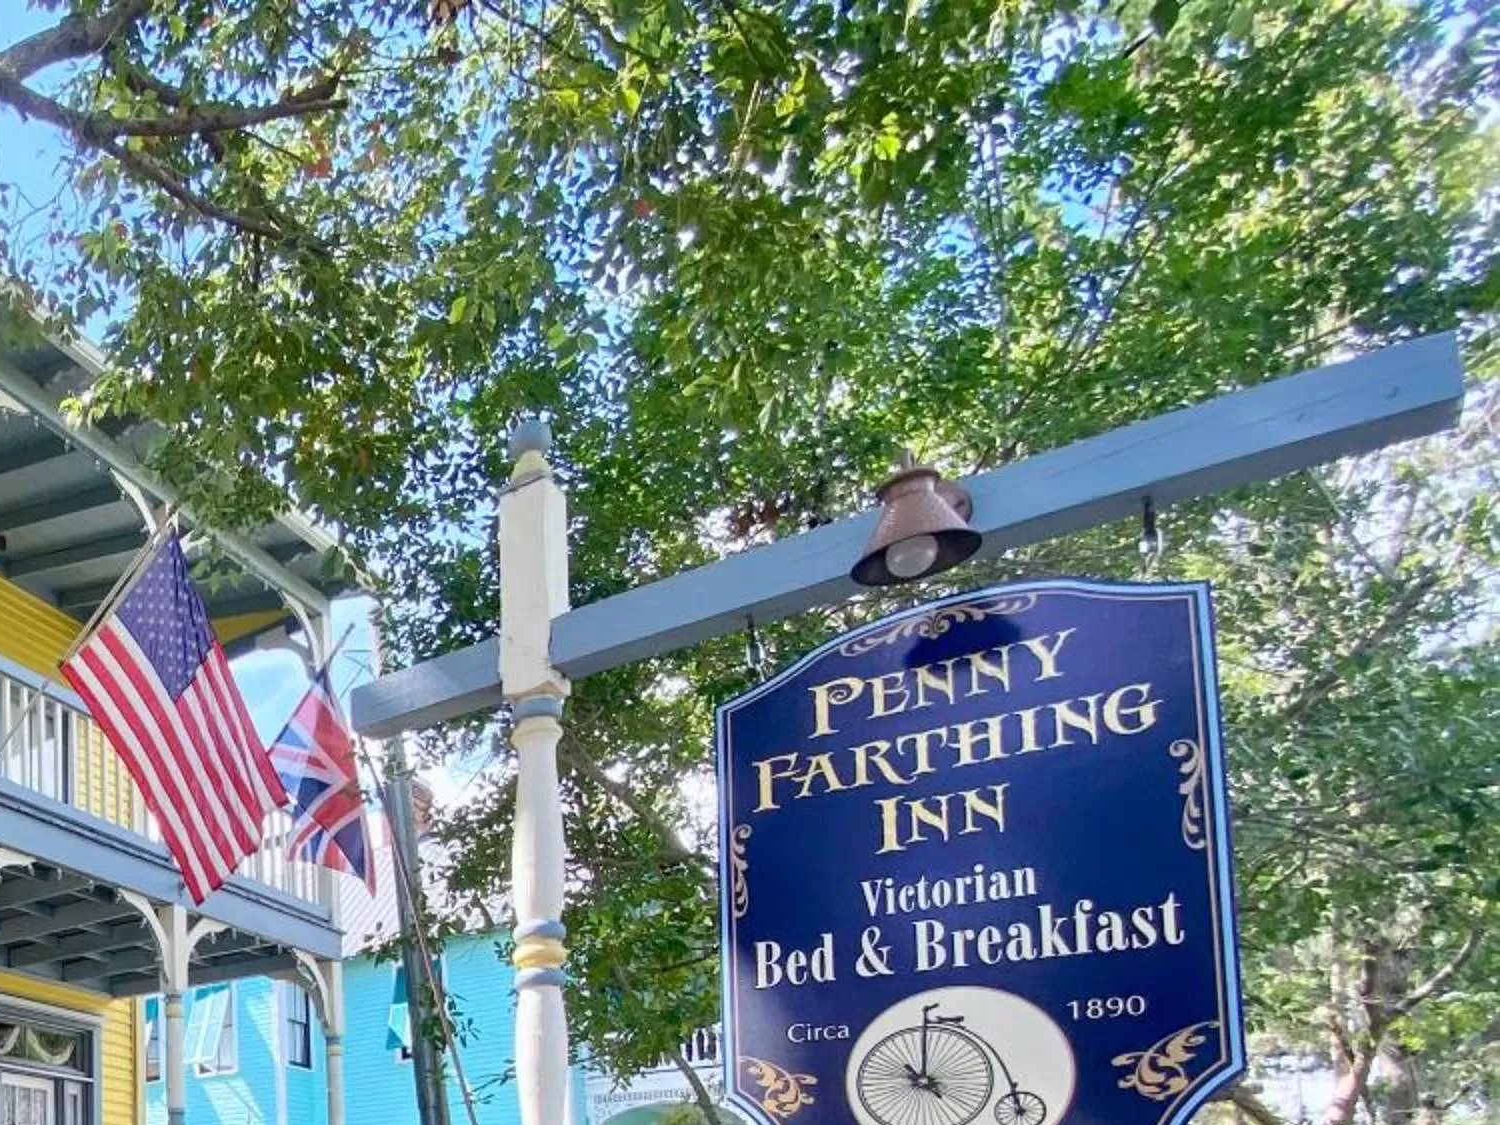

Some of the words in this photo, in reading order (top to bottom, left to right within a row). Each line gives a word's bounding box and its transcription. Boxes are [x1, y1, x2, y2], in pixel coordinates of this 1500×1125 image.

[808, 628, 1078, 739] PENNY
[752, 683, 1164, 813] FARTHING
[876, 784, 1010, 855] INN
[860, 863, 1037, 917] Victorian
[754, 934, 835, 989] Bed
[855, 926, 895, 979] &
[914, 891, 1185, 973] Breakfast
[787, 1021, 851, 1044] Circa
[1066, 994, 1147, 1022] 1890
